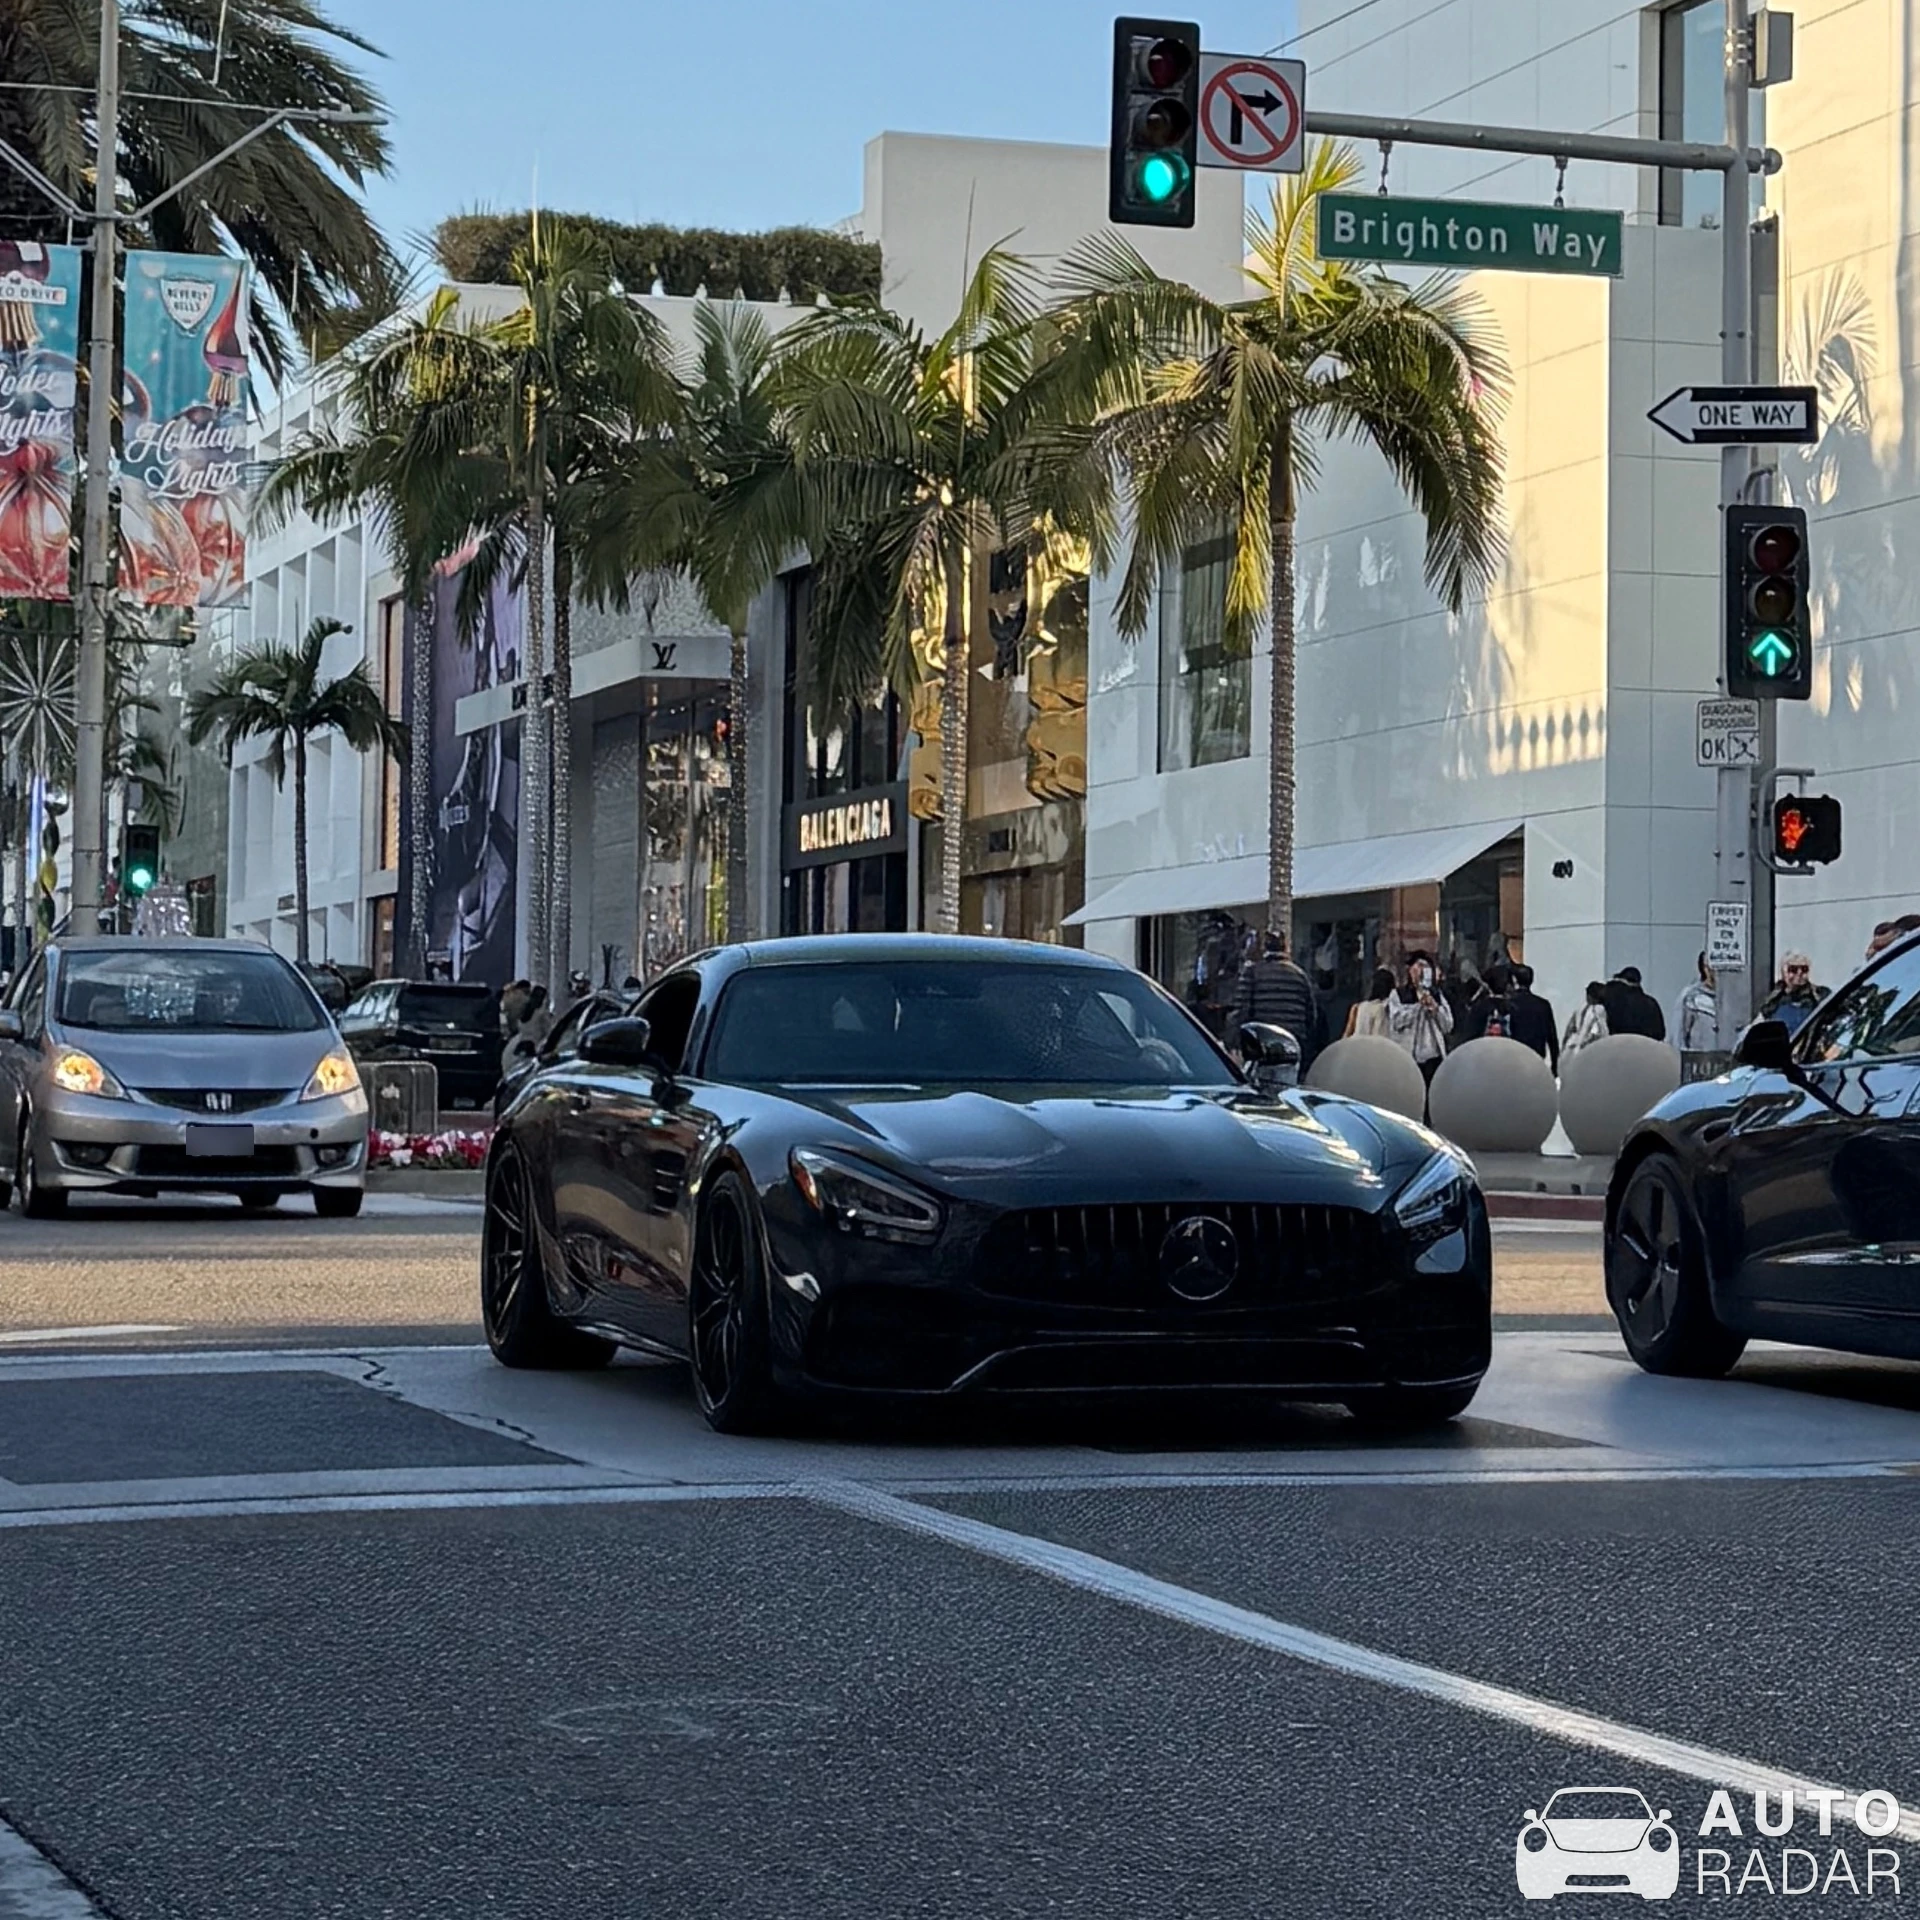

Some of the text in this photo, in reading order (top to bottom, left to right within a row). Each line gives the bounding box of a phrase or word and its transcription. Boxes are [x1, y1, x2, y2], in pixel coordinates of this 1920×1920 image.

[1334, 210, 1605, 268] Brighton Way
[167, 287, 209, 301] BEVERLY
[0, 409, 71, 455] ights
[1699, 404, 1796, 426] ONE WAY
[125, 419, 236, 465] Holiday
[144, 460, 242, 499] Lights
[1702, 738, 1725, 760] OK
[800, 798, 891, 852] BALENCIAGA
